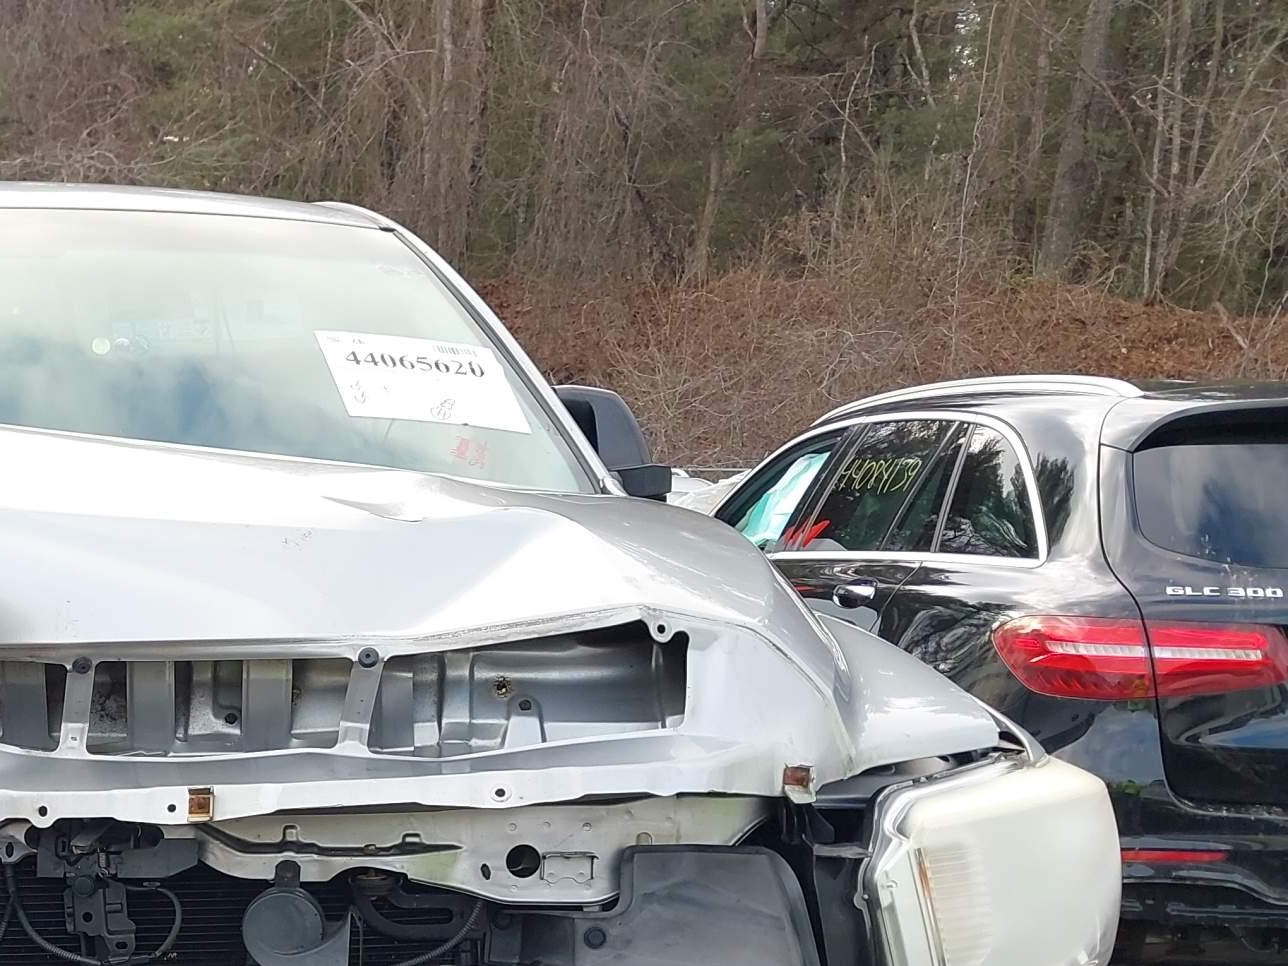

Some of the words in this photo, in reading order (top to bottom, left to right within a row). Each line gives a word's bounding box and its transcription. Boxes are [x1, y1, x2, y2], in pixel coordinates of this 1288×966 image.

[345, 350, 486, 378] 44065620
[1165, 586, 1221, 596] GLC
[1227, 586, 1284, 598] 300
